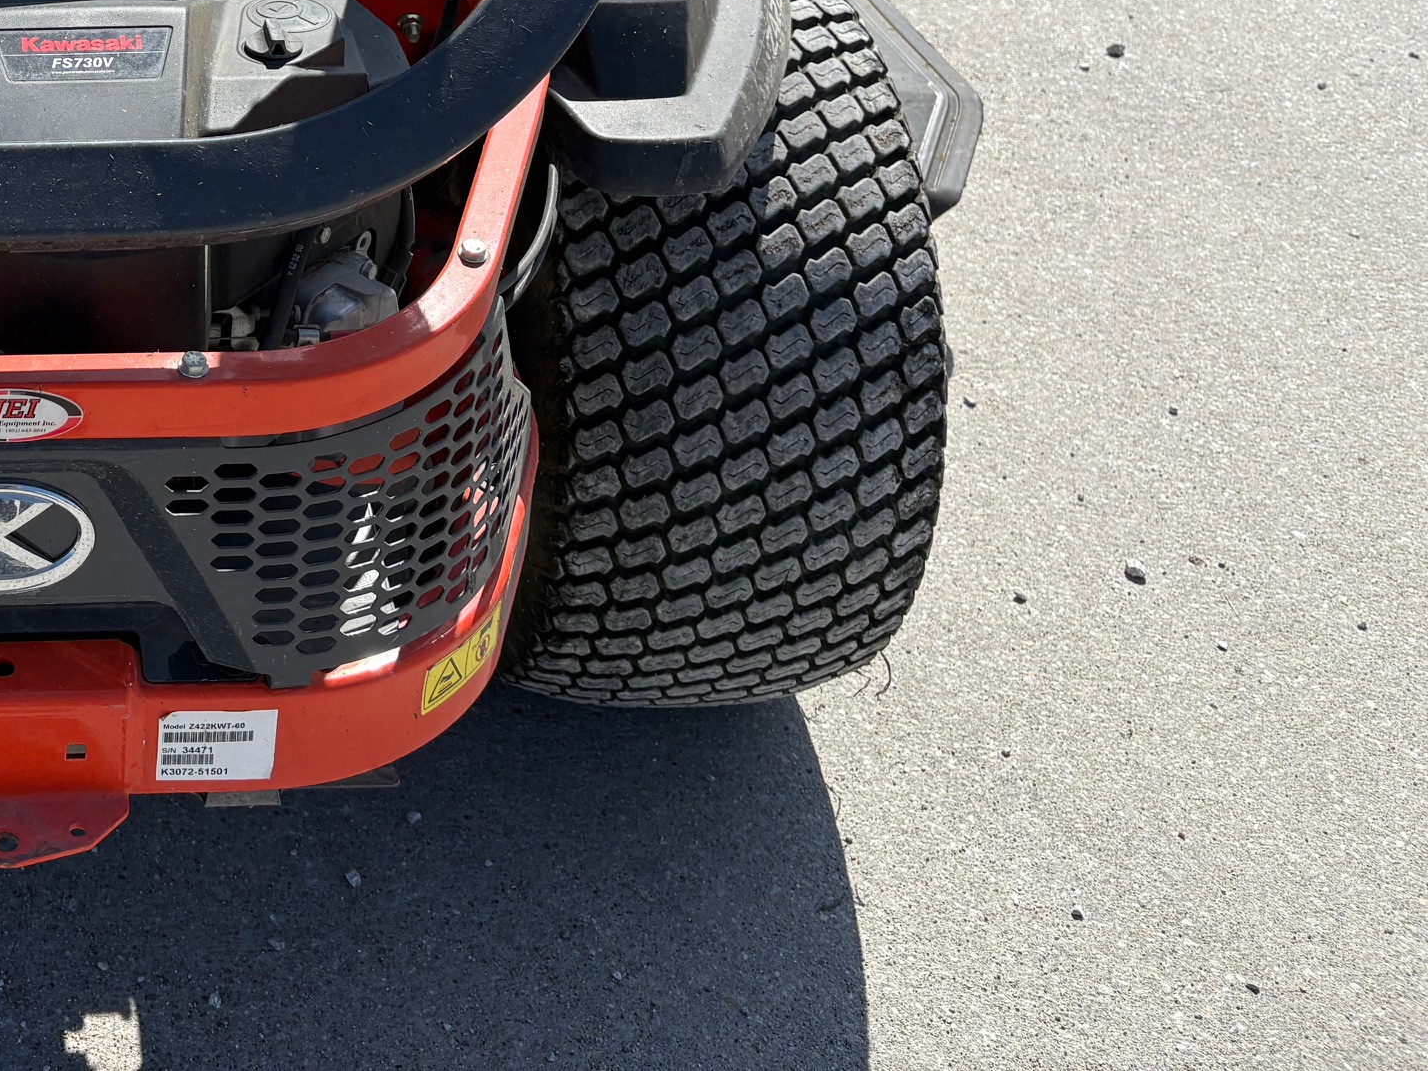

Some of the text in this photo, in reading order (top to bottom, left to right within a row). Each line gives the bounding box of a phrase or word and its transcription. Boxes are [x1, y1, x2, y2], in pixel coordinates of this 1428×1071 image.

[21, 34, 143, 53] Kawasaki
[52, 57, 115, 68] FS730V
[161, 768, 228, 776] K3072-51501
